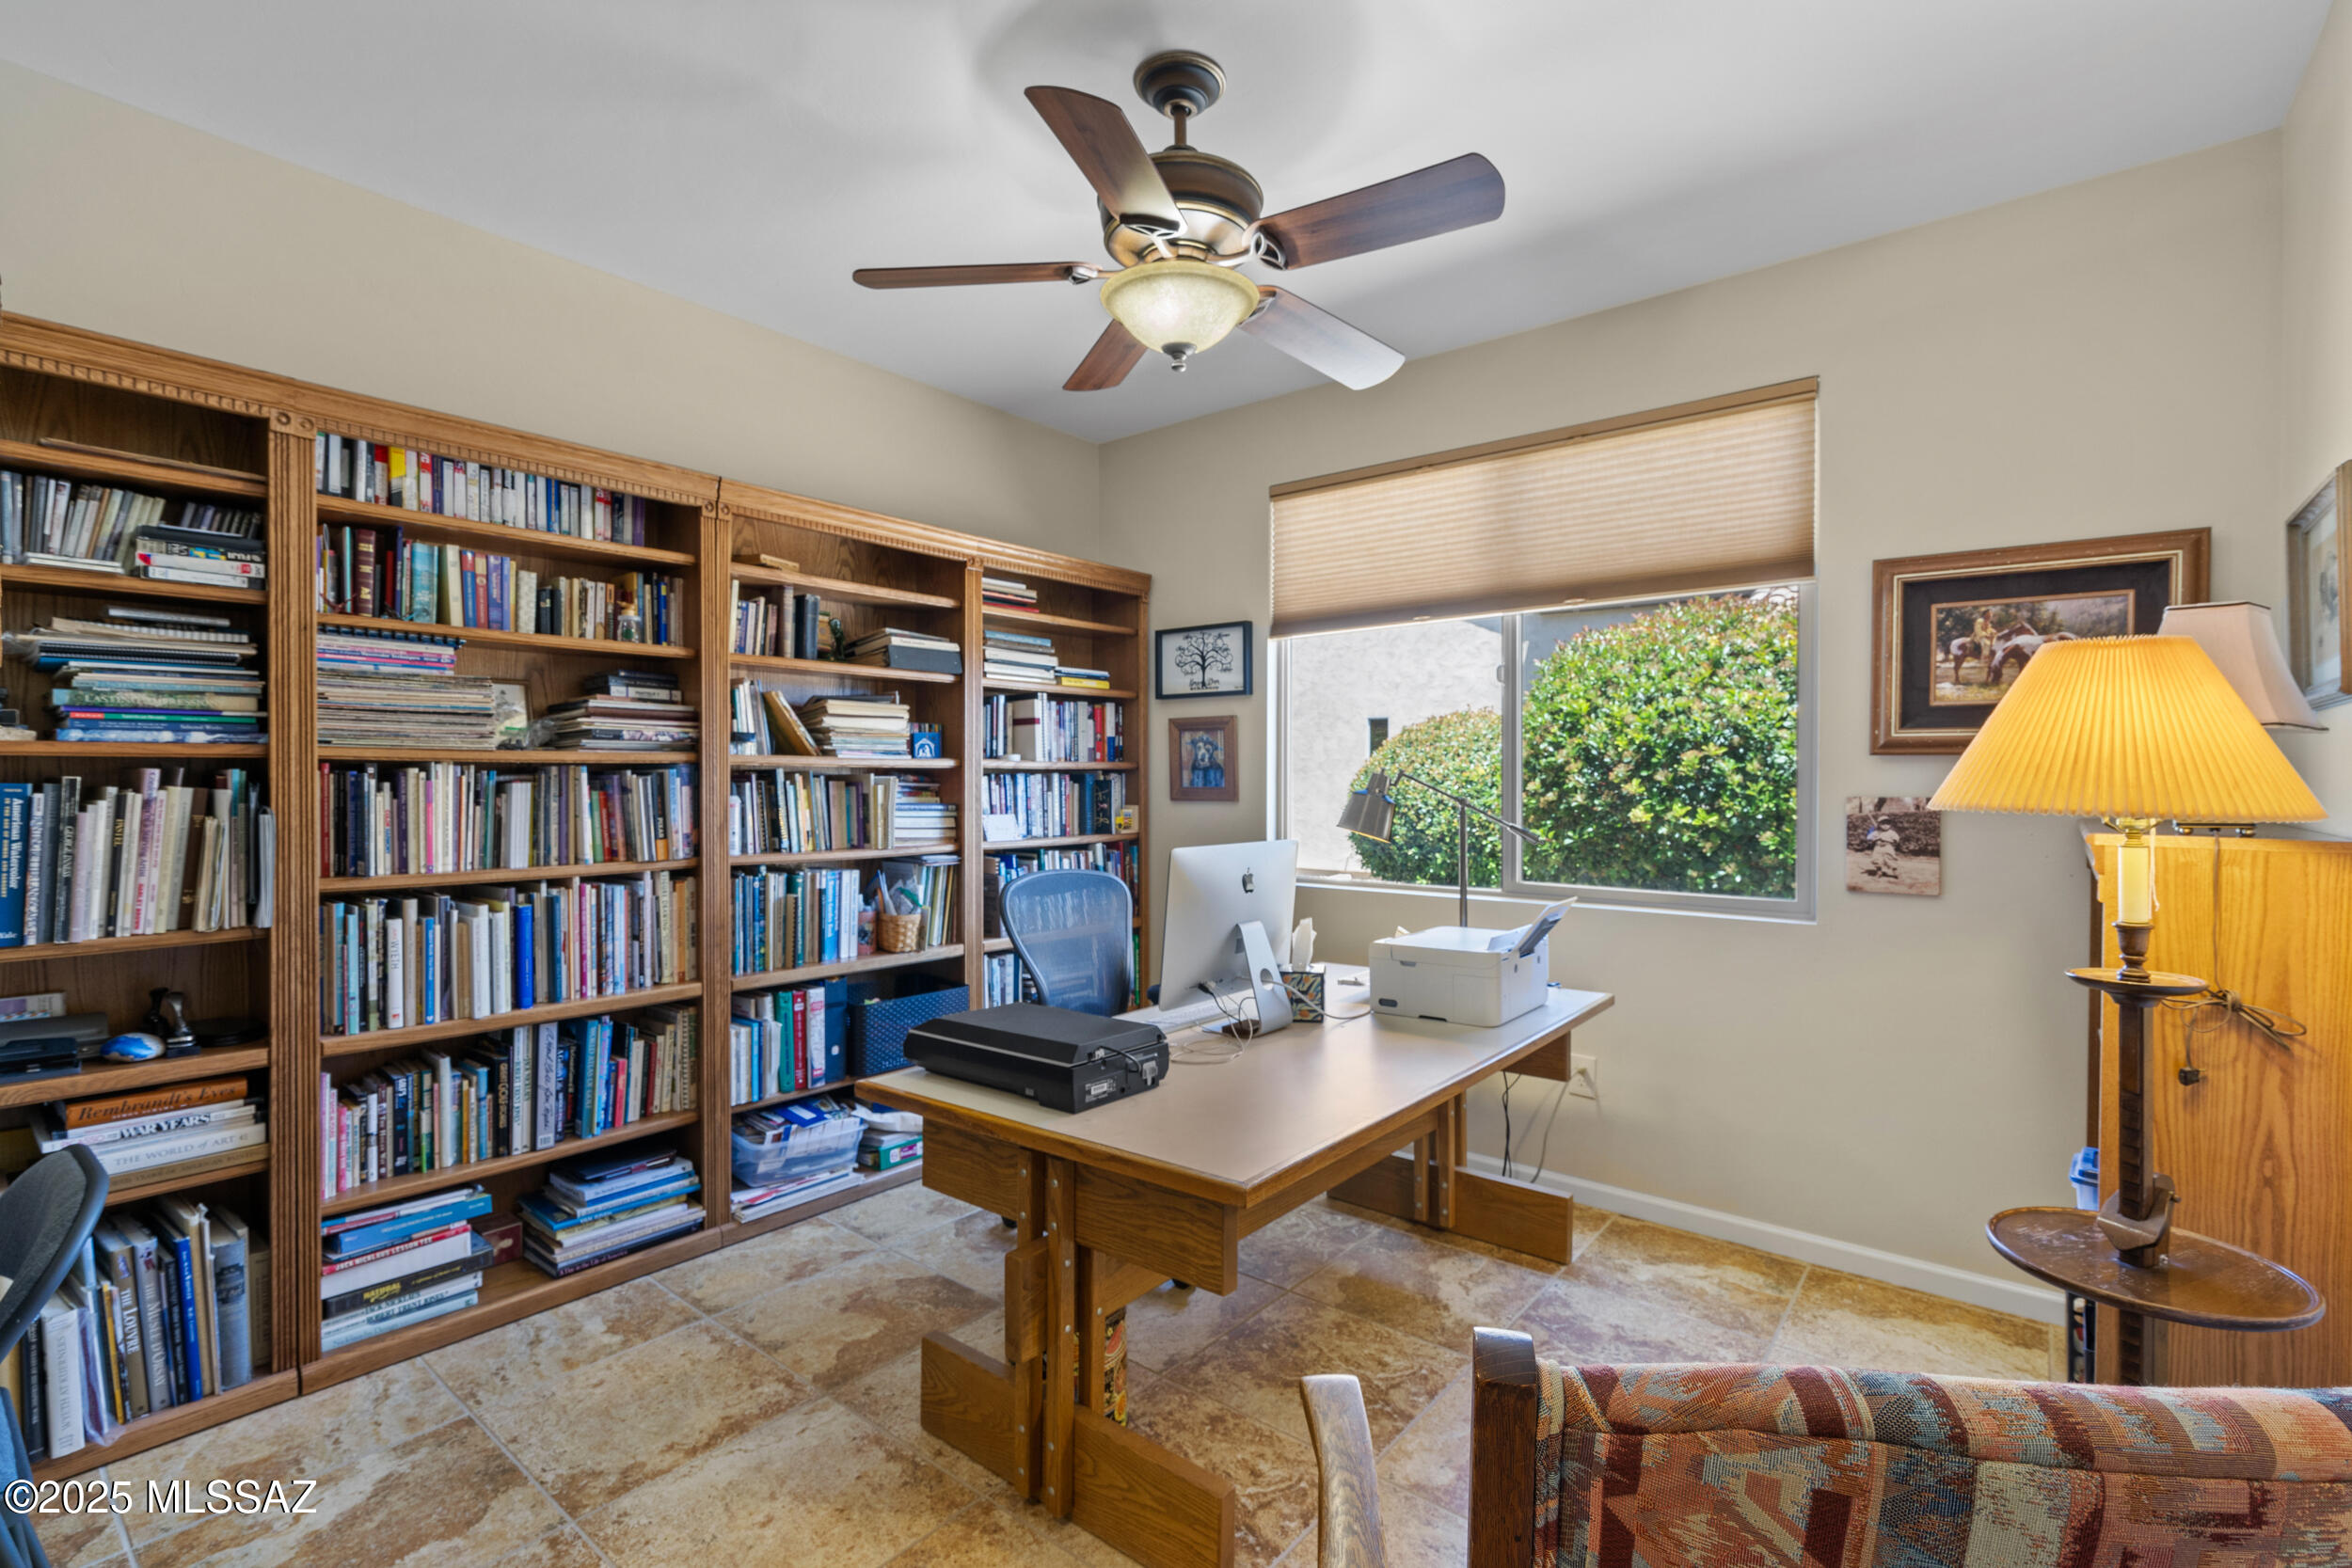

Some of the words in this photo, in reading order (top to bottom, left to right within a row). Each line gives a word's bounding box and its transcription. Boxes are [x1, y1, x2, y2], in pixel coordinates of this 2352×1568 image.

[11, 799, 24, 840] American
[114, 819, 125, 847] PASTEL
[9, 842, 22, 889] Watercolor
[139, 859, 148, 877] Artist
[390, 941, 400, 970] WYETH
[78, 1086, 192, 1121] Rembrandt's
[199, 1086, 235, 1102] Eyes
[498, 1084, 508, 1104] GOLF
[119, 1124, 155, 1139] WAR
[157, 1114, 211, 1132] YEARS
[114, 1155, 140, 1166] THE
[146, 1146, 195, 1160] WORLD
[198, 1141, 208, 1150] of
[212, 1135, 235, 1147] ART
[336, 1260, 354, 1271] JACK
[356, 1249, 389, 1266] NICKLAUS
[391, 1242, 419, 1254] LESSON
[420, 1237, 433, 1246] TEE
[120, 1288, 133, 1308] THE
[121, 1307, 140, 1354] LOUVRE
[145, 1284, 155, 1300] THE
[151, 1343, 166, 1387] D'ORSAY
[59, 1385, 69, 1395] AT
[58, 1397, 72, 1431] WYETH
